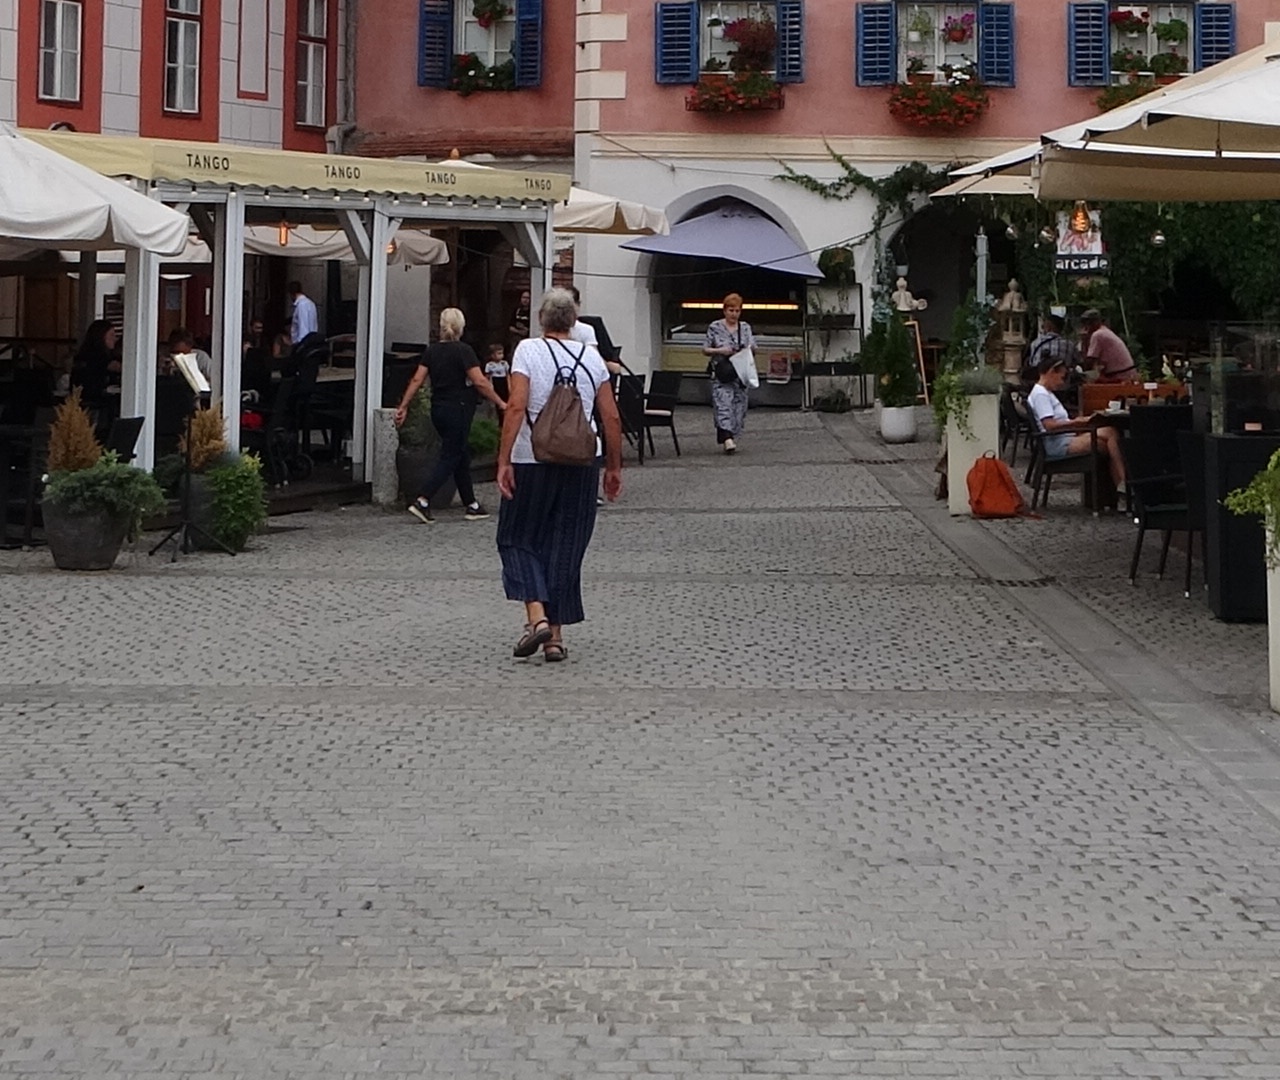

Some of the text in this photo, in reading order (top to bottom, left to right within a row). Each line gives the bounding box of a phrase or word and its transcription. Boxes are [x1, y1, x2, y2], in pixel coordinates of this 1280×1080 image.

[186, 153, 230, 171] TANGO
[324, 165, 361, 180] TANGO
[425, 171, 457, 185] TANGO
[524, 178, 552, 191] TANGO
[1055, 255, 1109, 270] arcade
